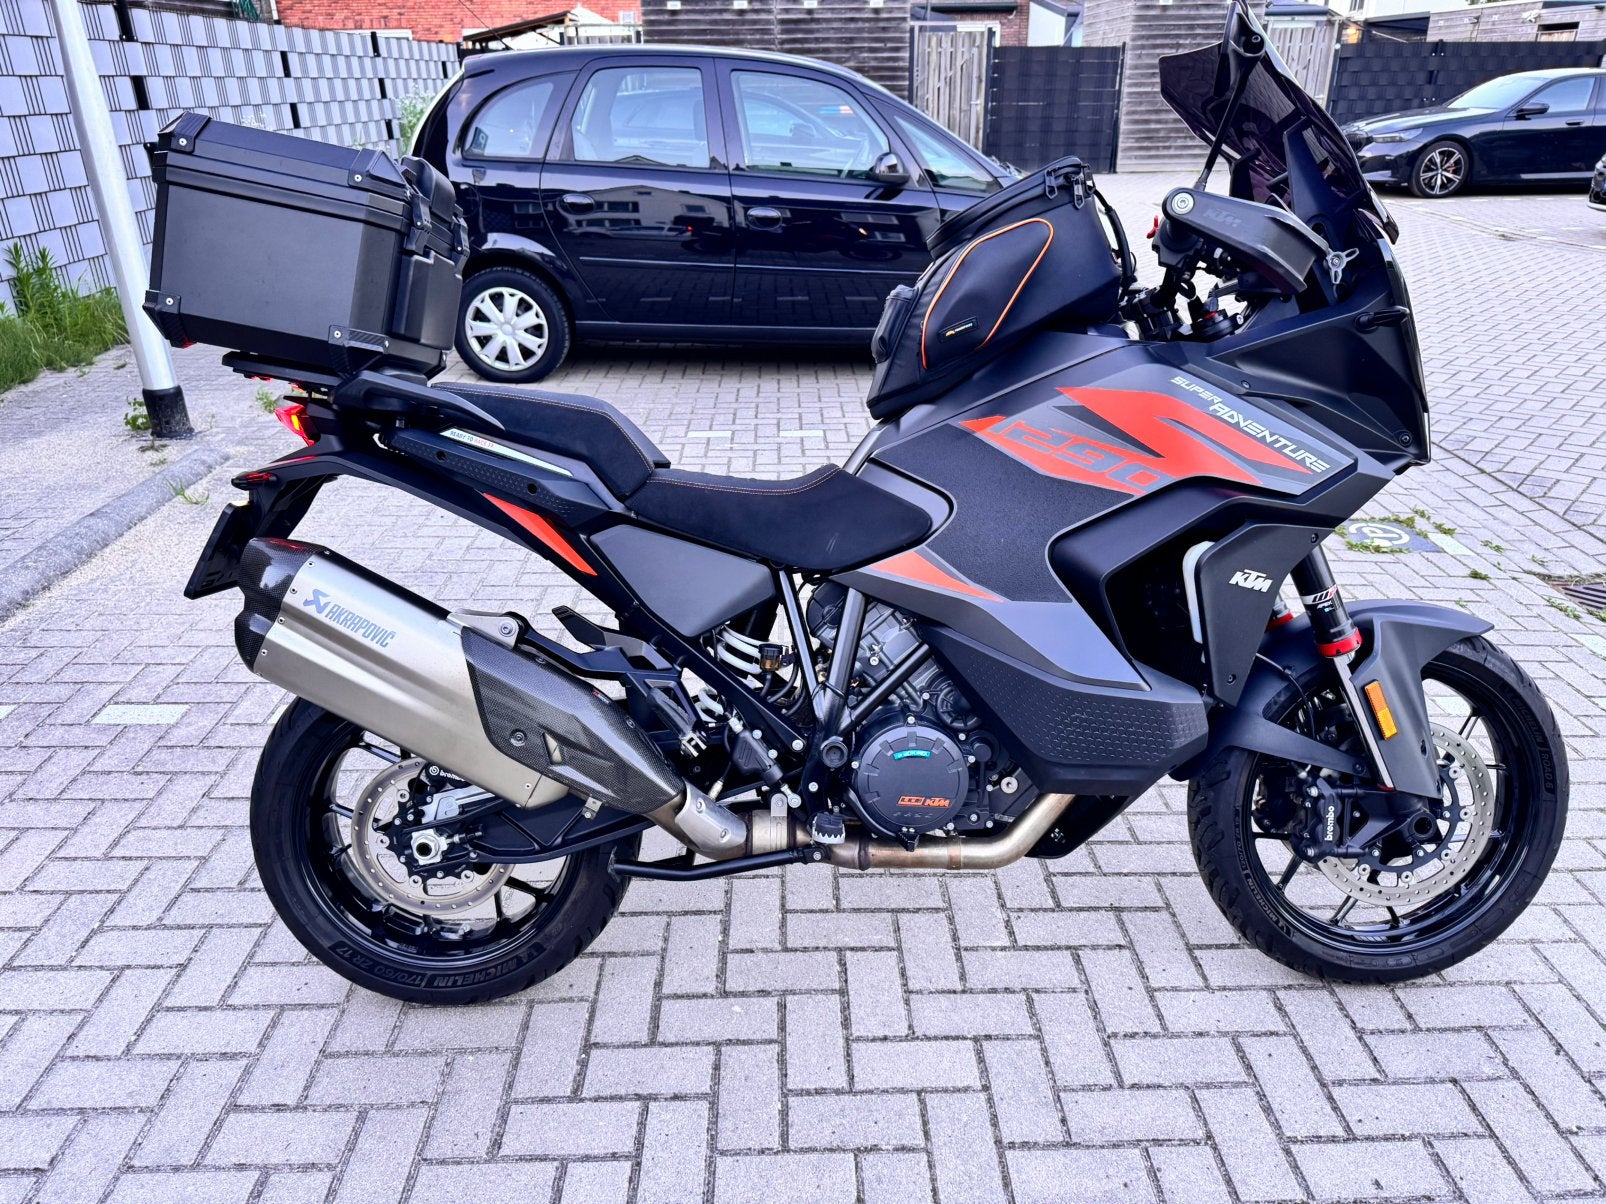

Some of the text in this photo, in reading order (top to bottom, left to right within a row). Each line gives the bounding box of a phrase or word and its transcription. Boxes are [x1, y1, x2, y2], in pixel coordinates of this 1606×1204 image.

[450, 430, 466, 440] READY
[1170, 376, 1331, 473] SUPER ADVENTURE
[1228, 569, 1273, 593] KTM
[1324, 805, 1335, 841] brembo
[1247, 878, 1279, 922] MICHELIN
[373, 965, 422, 985] 170/60
[433, 959, 518, 987] MICHELIN
